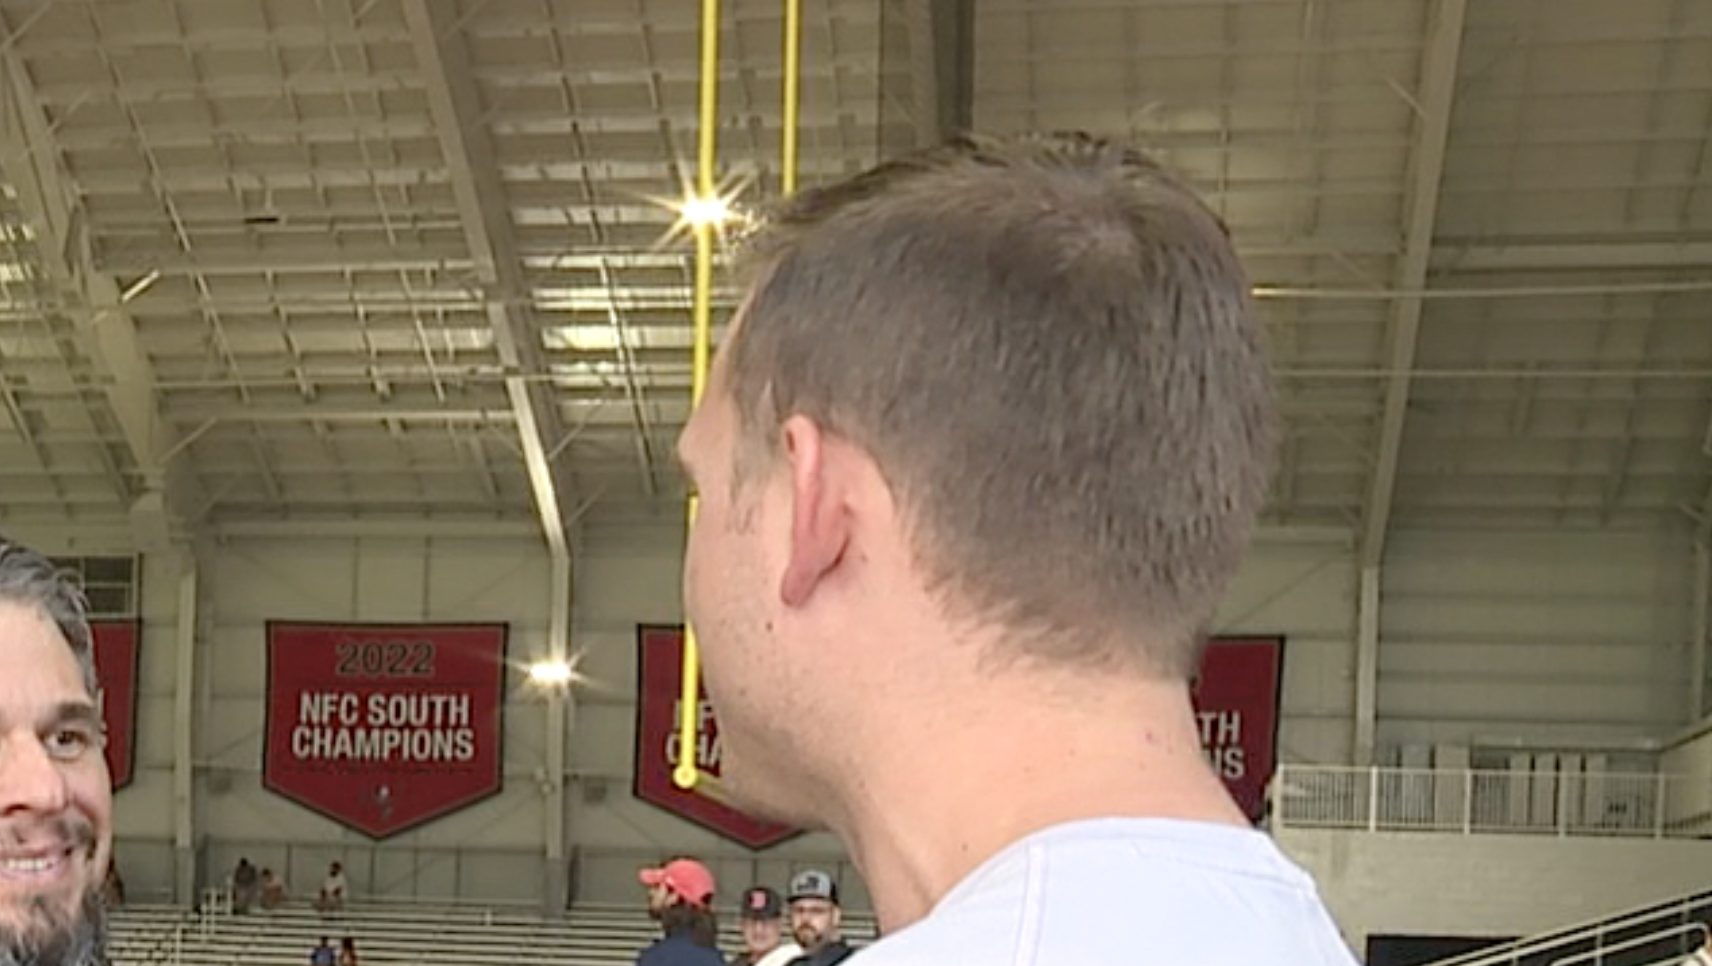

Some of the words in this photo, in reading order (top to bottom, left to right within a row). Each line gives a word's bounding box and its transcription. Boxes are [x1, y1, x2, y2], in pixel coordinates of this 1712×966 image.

[336, 641, 435, 677] 2022
[300, 692, 359, 725] NFC
[366, 693, 470, 727] SOUTH
[291, 725, 475, 761] CHAMPIONS
